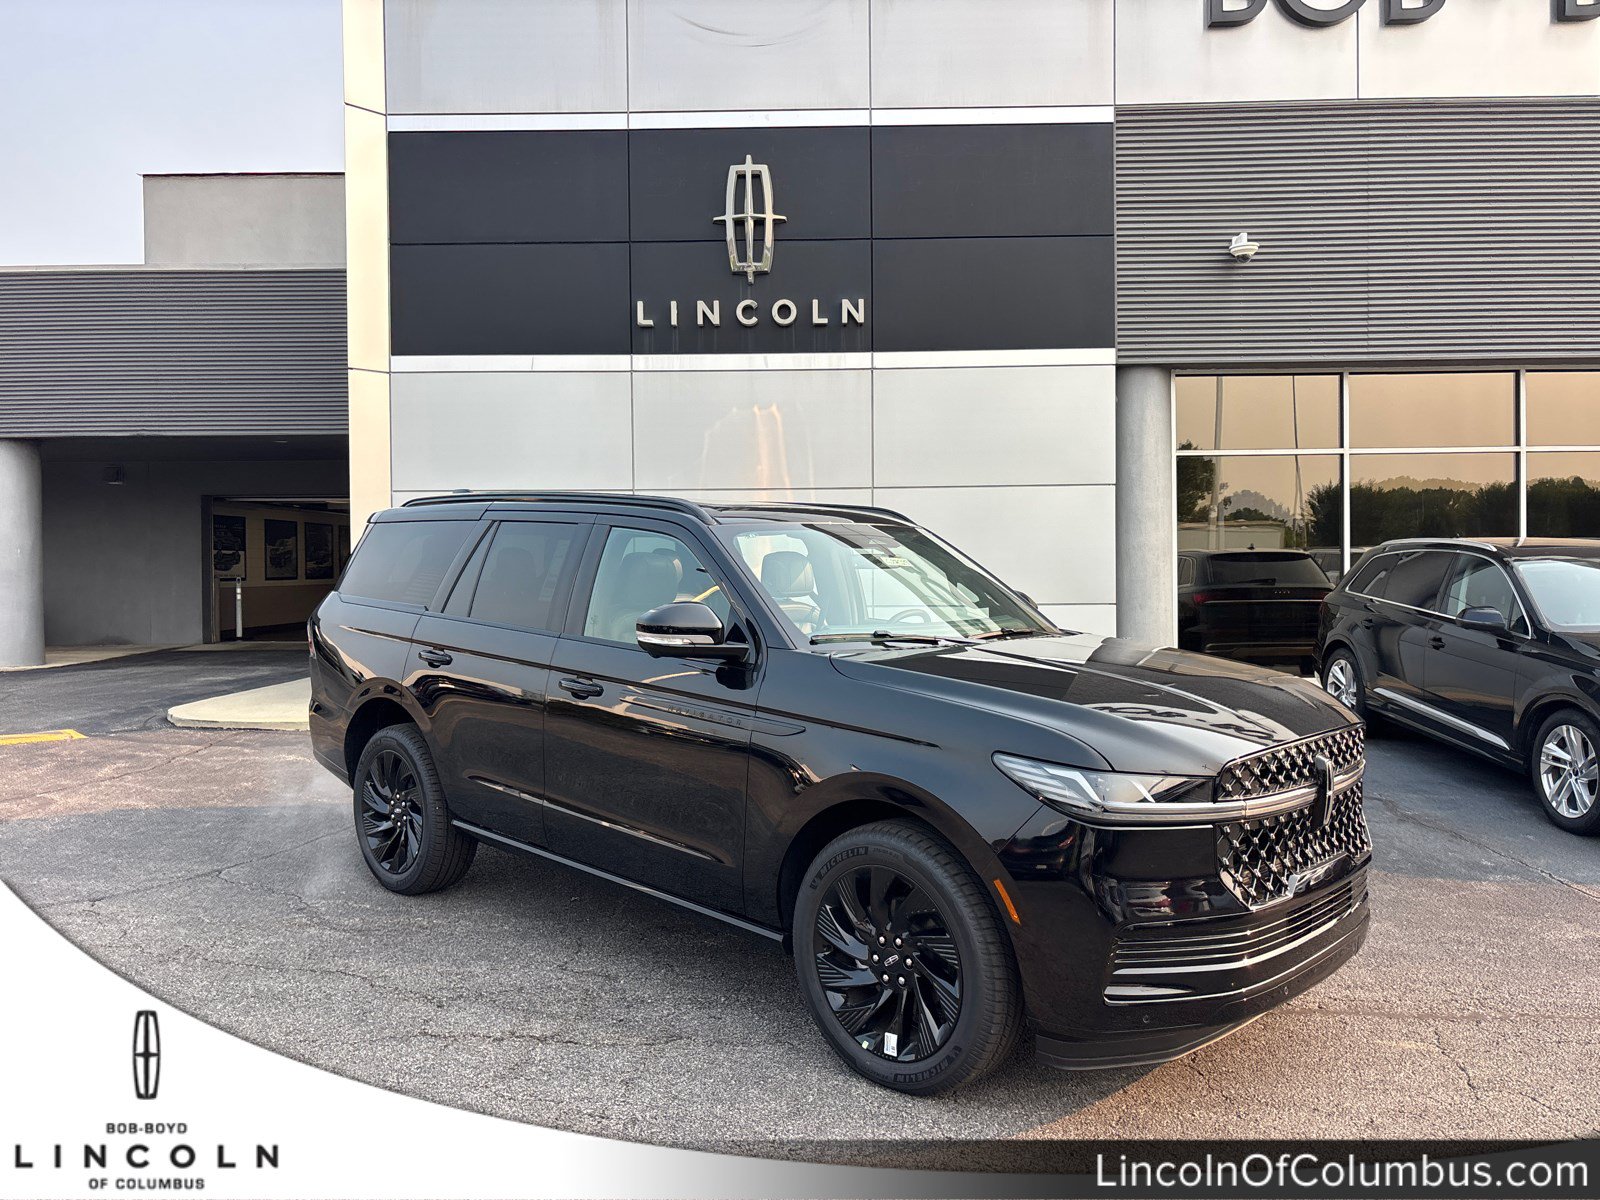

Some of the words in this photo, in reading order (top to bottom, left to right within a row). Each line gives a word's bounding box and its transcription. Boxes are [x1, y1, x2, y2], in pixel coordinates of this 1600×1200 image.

[636, 298, 866, 327] LINCOLN
[820, 846, 868, 878] MICHELIN
[896, 1057, 949, 1083] MICHELIN
